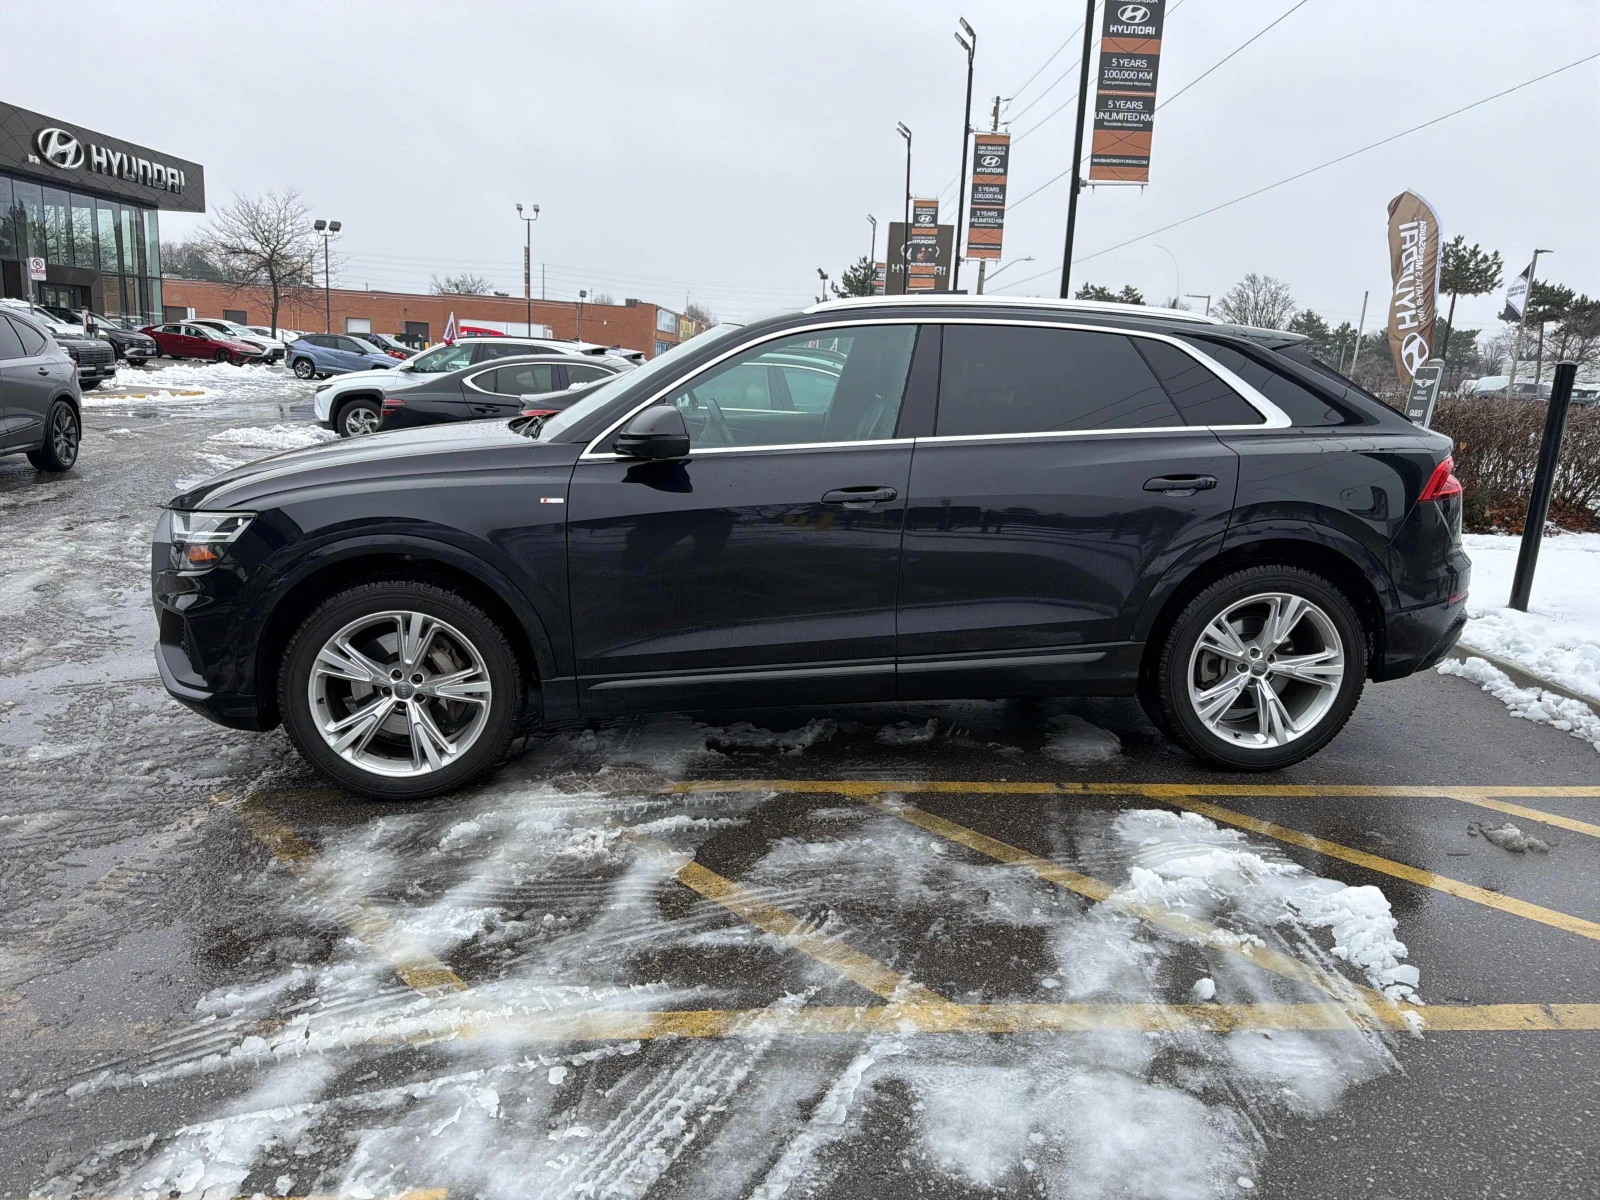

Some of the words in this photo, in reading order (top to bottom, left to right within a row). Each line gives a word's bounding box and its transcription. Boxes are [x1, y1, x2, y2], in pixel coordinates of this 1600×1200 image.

[1109, 24, 1156, 35] HYUNDAI
[1111, 58, 1117, 67] 5
[1119, 58, 1147, 68] YEARS
[1103, 70, 1137, 80] 100,000
[1138, 71, 1153, 80] KM
[1107, 99, 1113, 108] 5
[1115, 100, 1143, 109] YEARS
[1094, 111, 1139, 121] UNLIMITED
[1140, 113, 1154, 122] KM
[89, 143, 186, 195] HYUNDAI
[1409, 409, 1424, 417] GUEST
